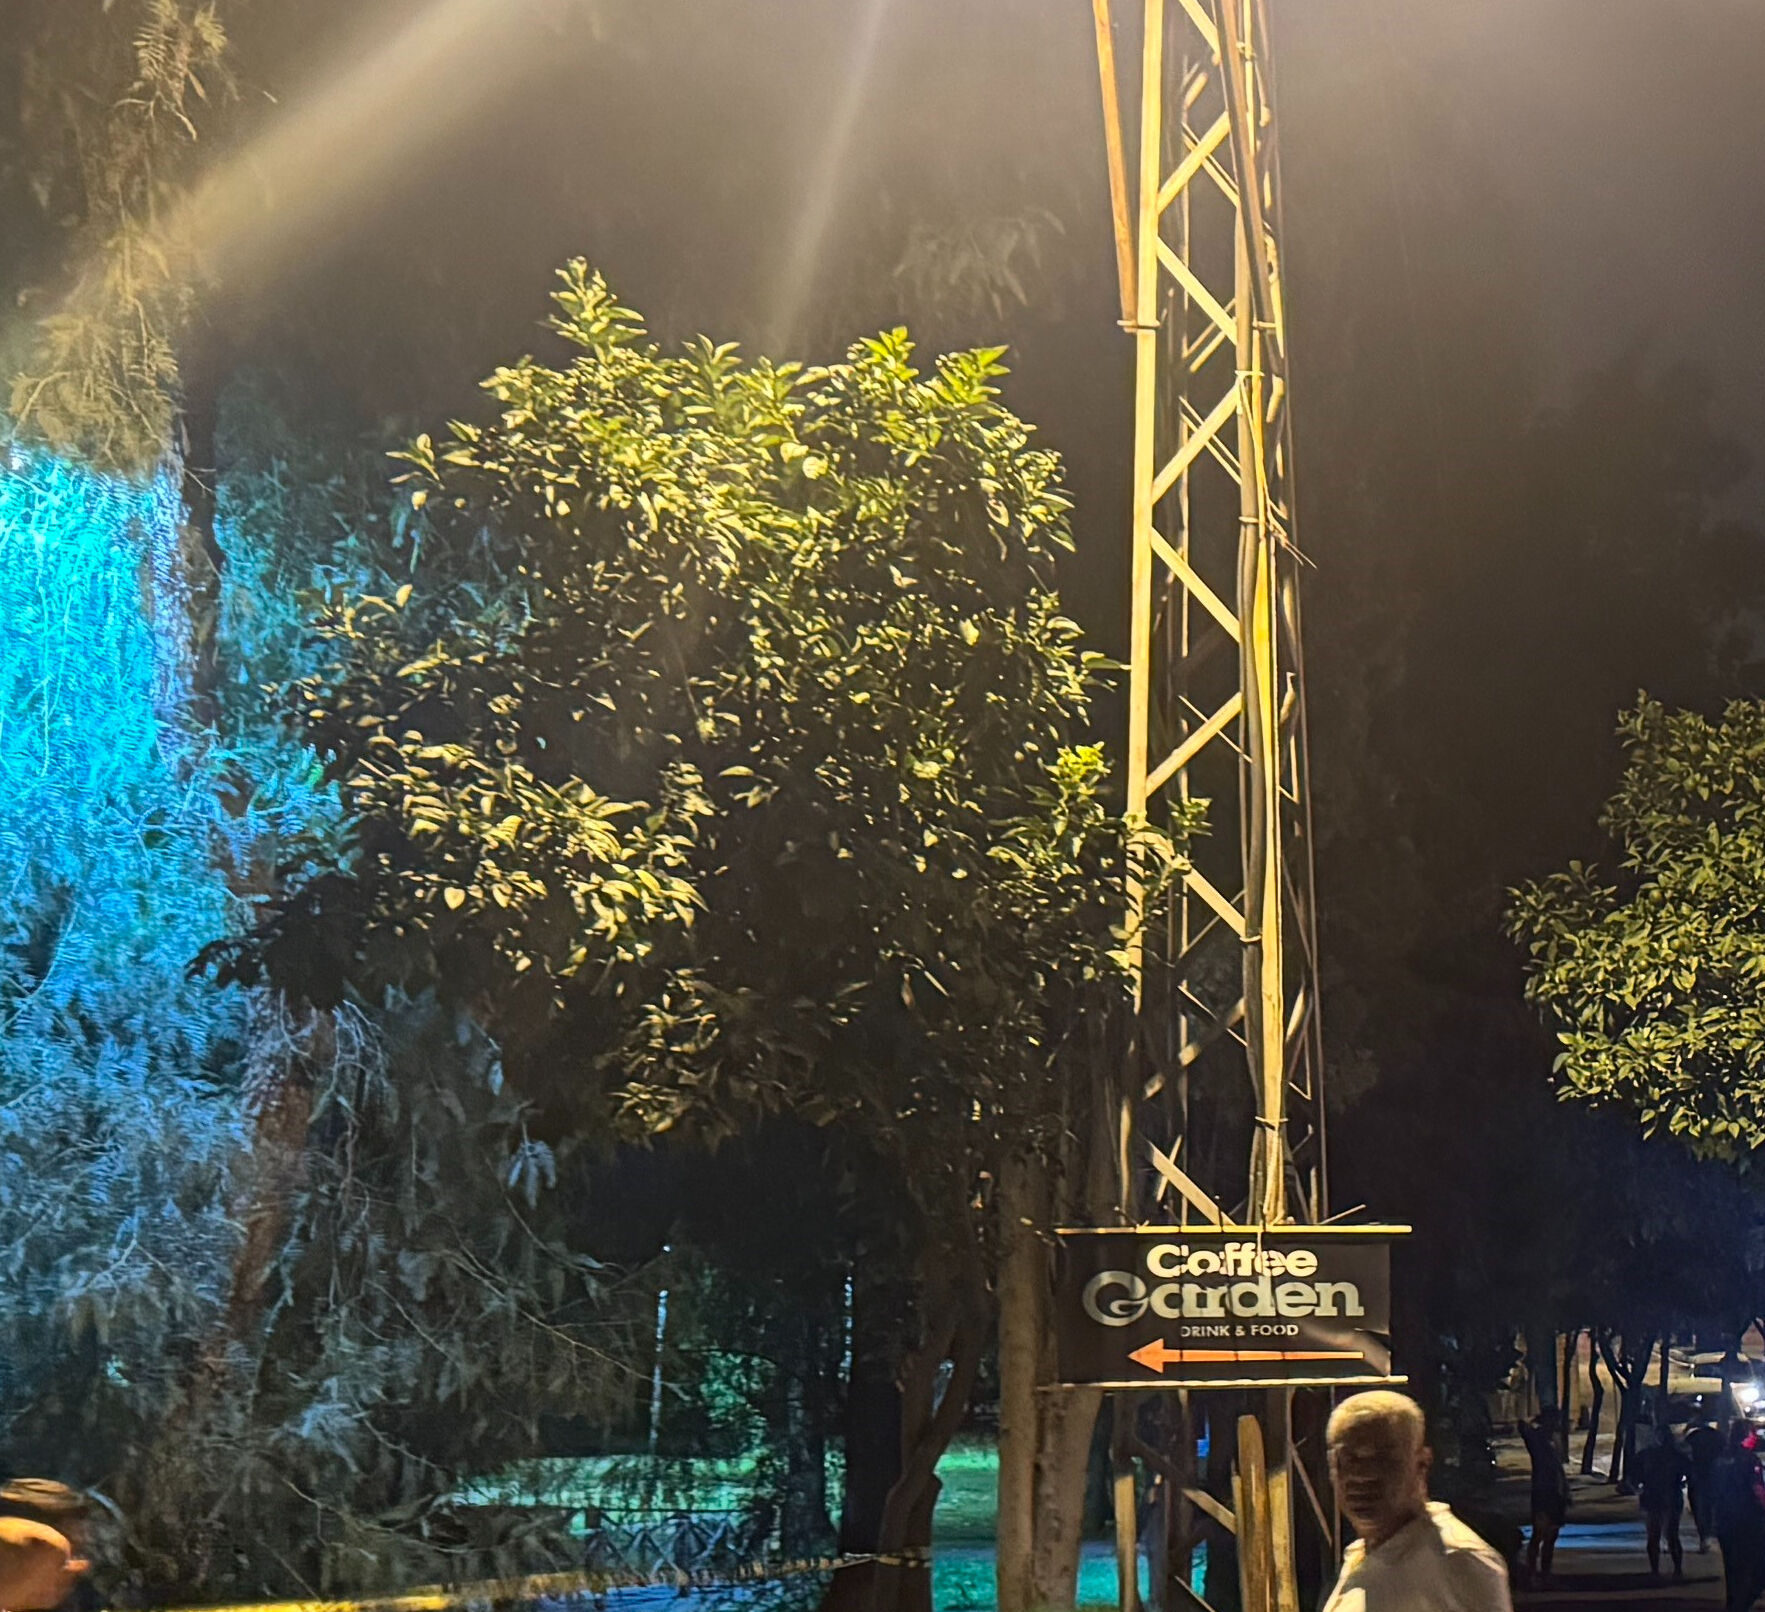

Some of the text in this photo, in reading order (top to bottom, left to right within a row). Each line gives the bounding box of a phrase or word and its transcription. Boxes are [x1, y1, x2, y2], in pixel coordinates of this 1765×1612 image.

[1146, 1242, 1318, 1278] Coffee
[1082, 1270, 1365, 1327] Garden
[1180, 1324, 1299, 1338] DRINK & FOOD
